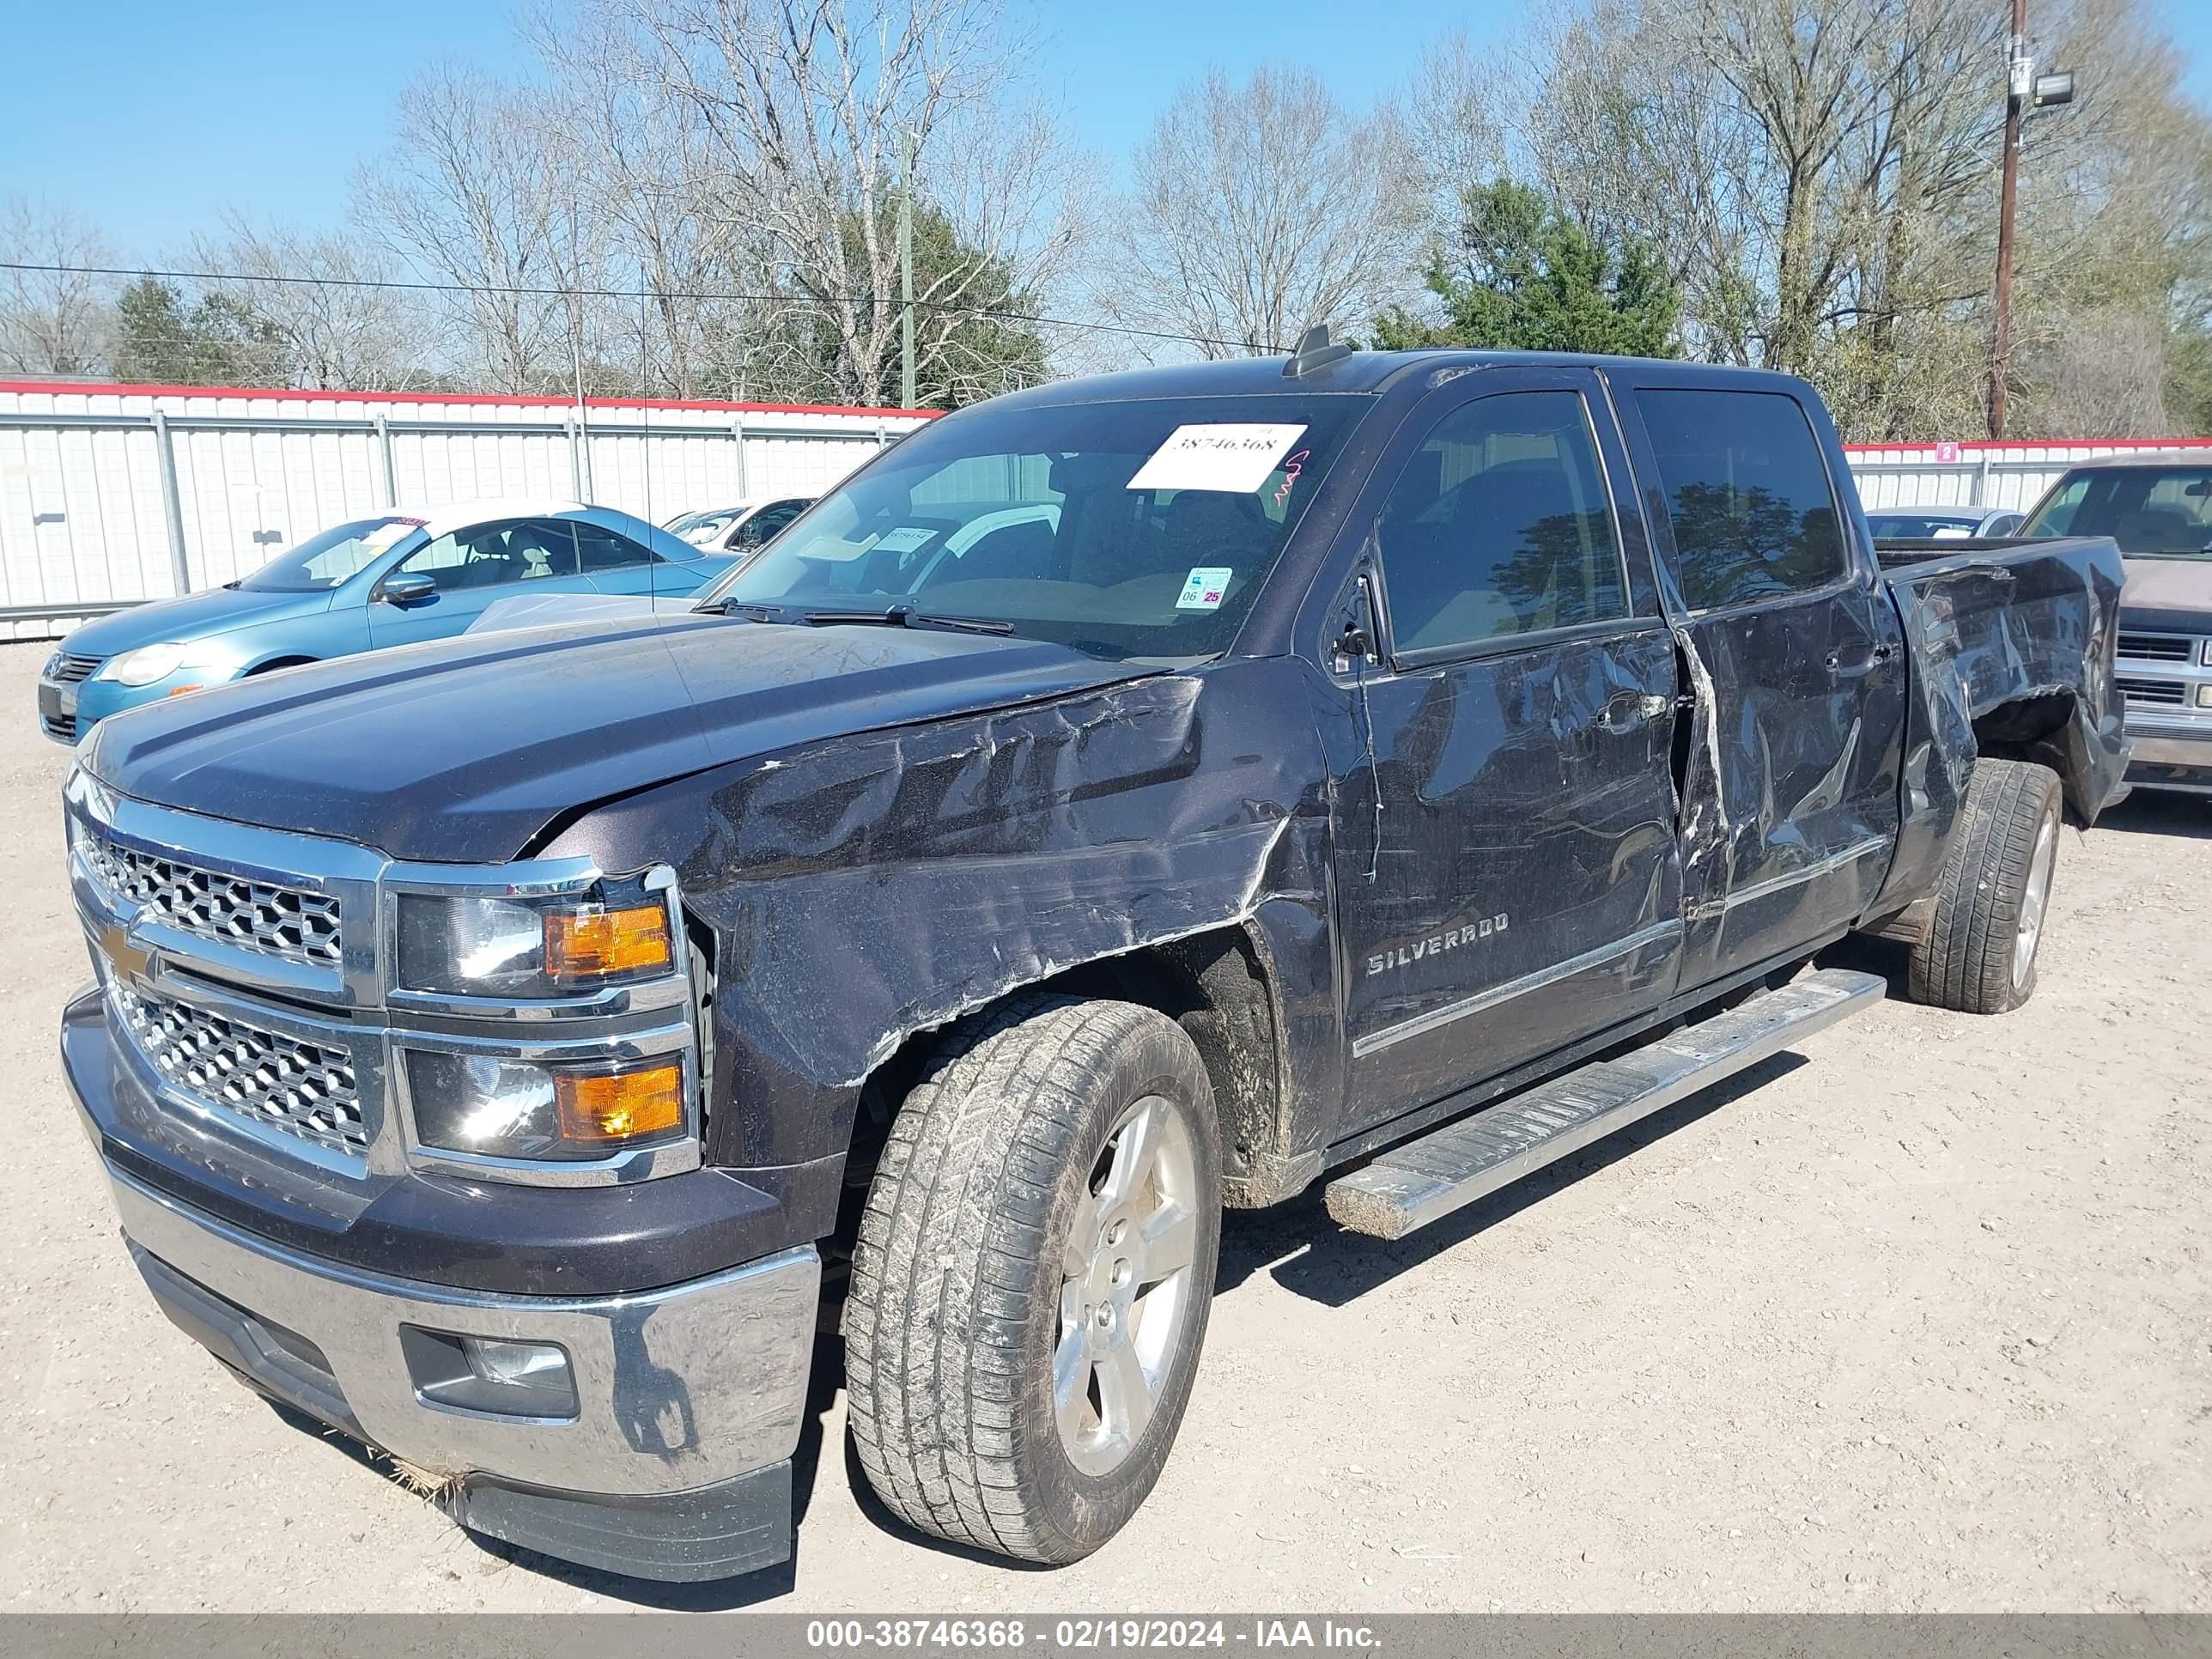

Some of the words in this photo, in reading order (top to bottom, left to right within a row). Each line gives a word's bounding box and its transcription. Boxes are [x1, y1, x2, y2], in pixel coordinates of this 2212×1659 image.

[1942, 446, 1952, 459] 2
[1182, 591, 1198, 602] 06
[1203, 591, 1220, 602] 25
[1366, 912, 1510, 976] SILVERADO
